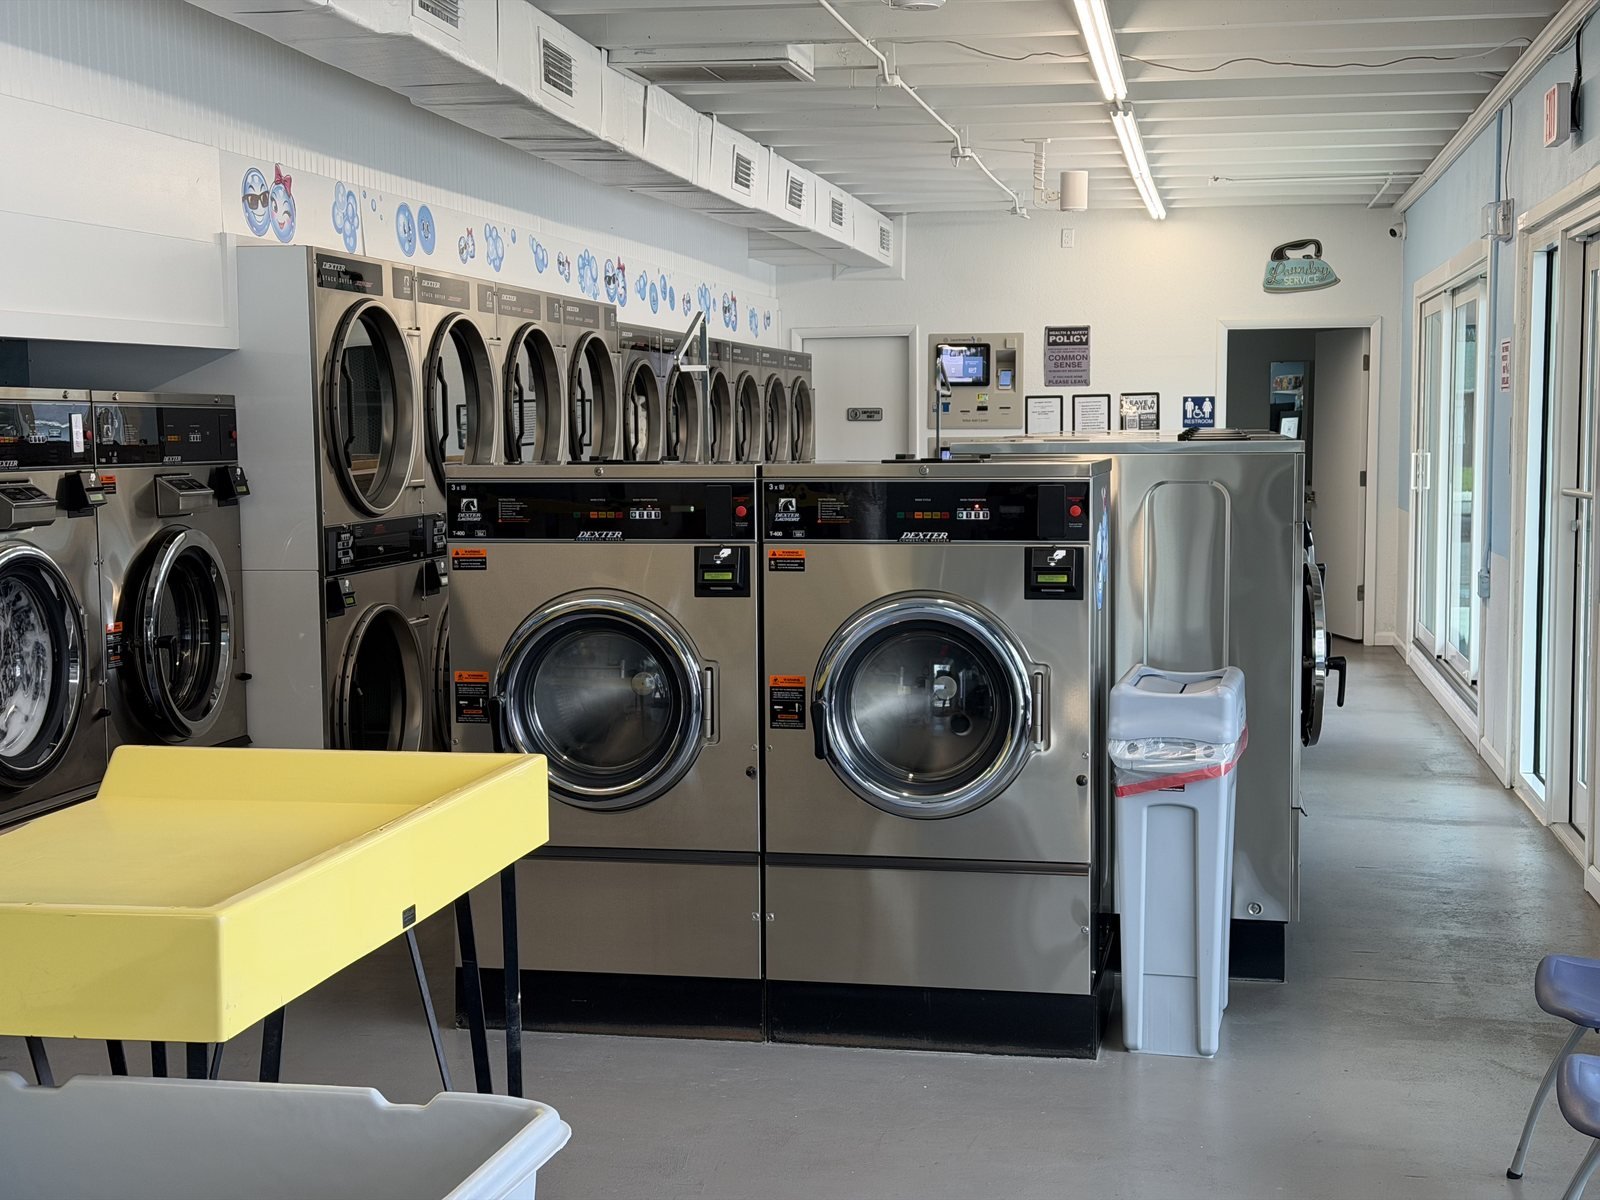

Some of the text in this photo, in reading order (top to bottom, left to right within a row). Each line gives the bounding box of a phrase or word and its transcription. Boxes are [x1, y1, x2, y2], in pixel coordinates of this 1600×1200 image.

[322, 261, 346, 272] DEXTER
[1284, 274, 1319, 286] SERVICE
[1049, 335, 1088, 343] POLICY
[1053, 361, 1083, 369] SENSE
